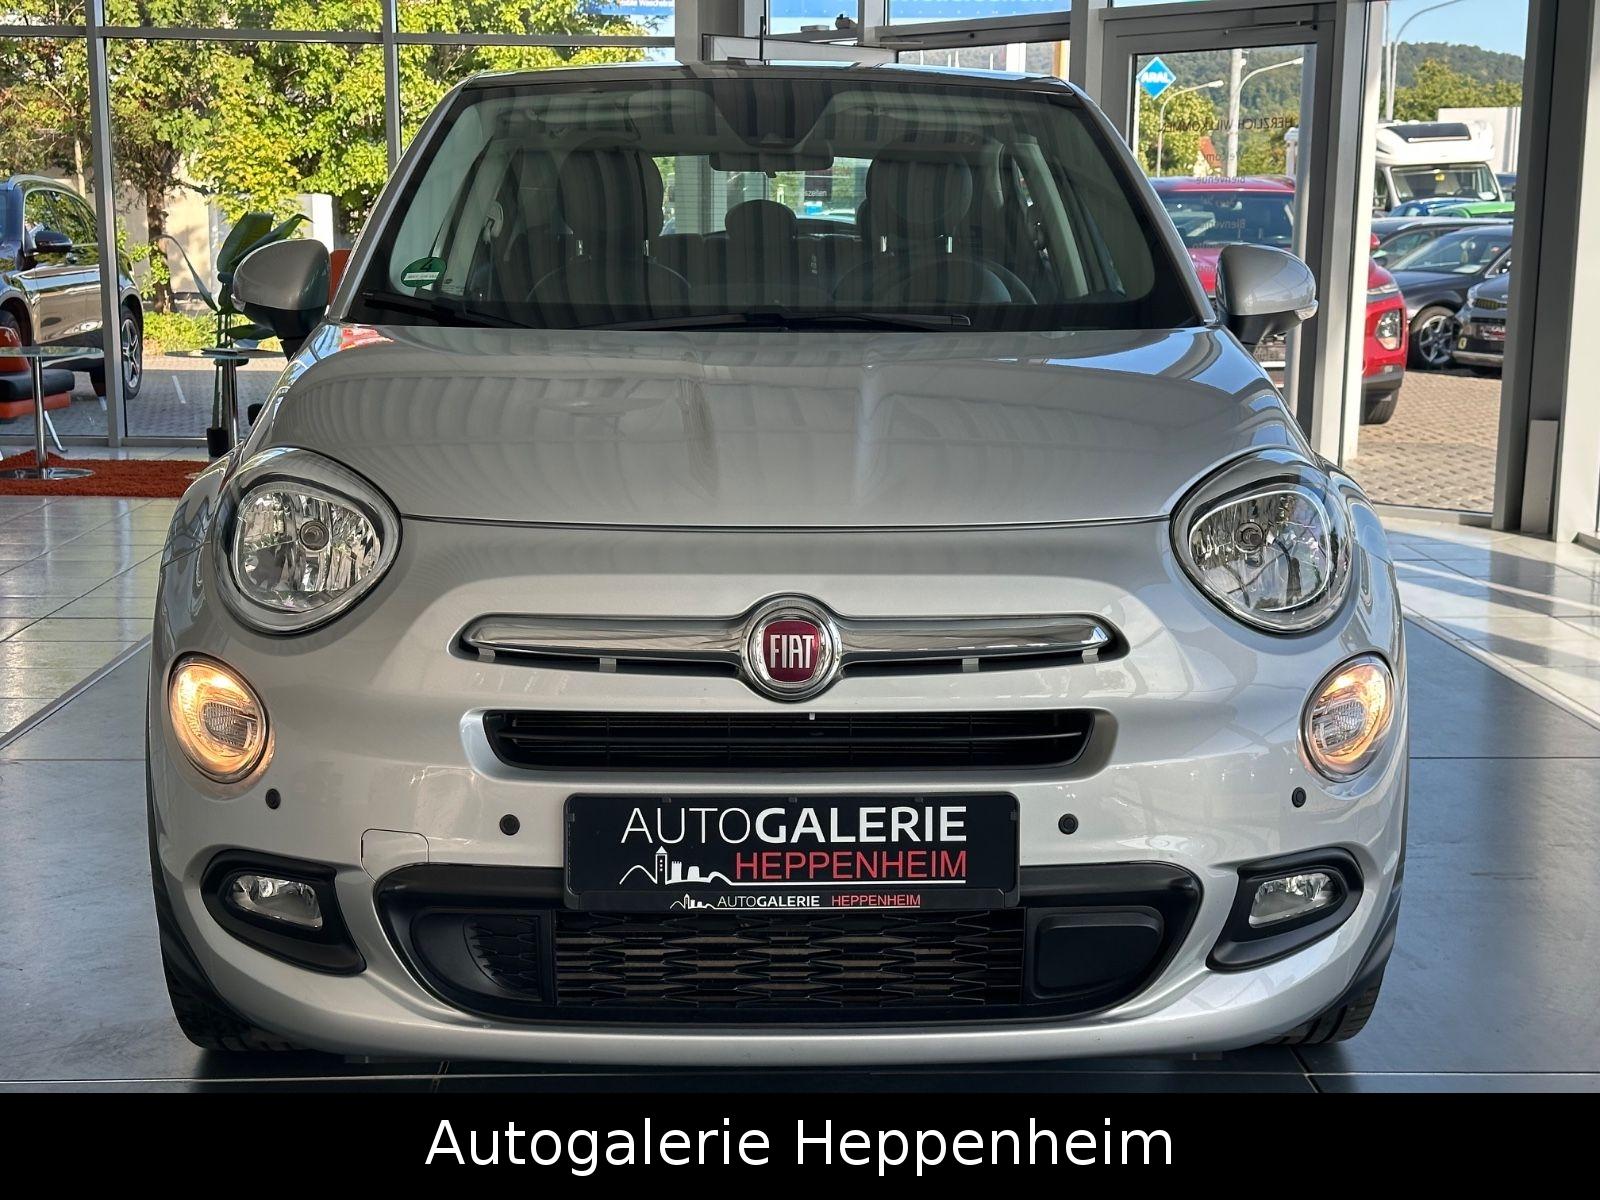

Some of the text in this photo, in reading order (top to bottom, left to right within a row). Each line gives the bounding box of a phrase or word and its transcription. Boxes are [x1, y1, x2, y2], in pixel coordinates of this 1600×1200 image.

[769, 634, 815, 669] FIAT
[620, 805, 967, 844] AUTOGALERIE
[736, 850, 967, 880] HEPPENHEIM
[717, 894, 921, 908] AUTOGALERIE HEPPENHEIM
